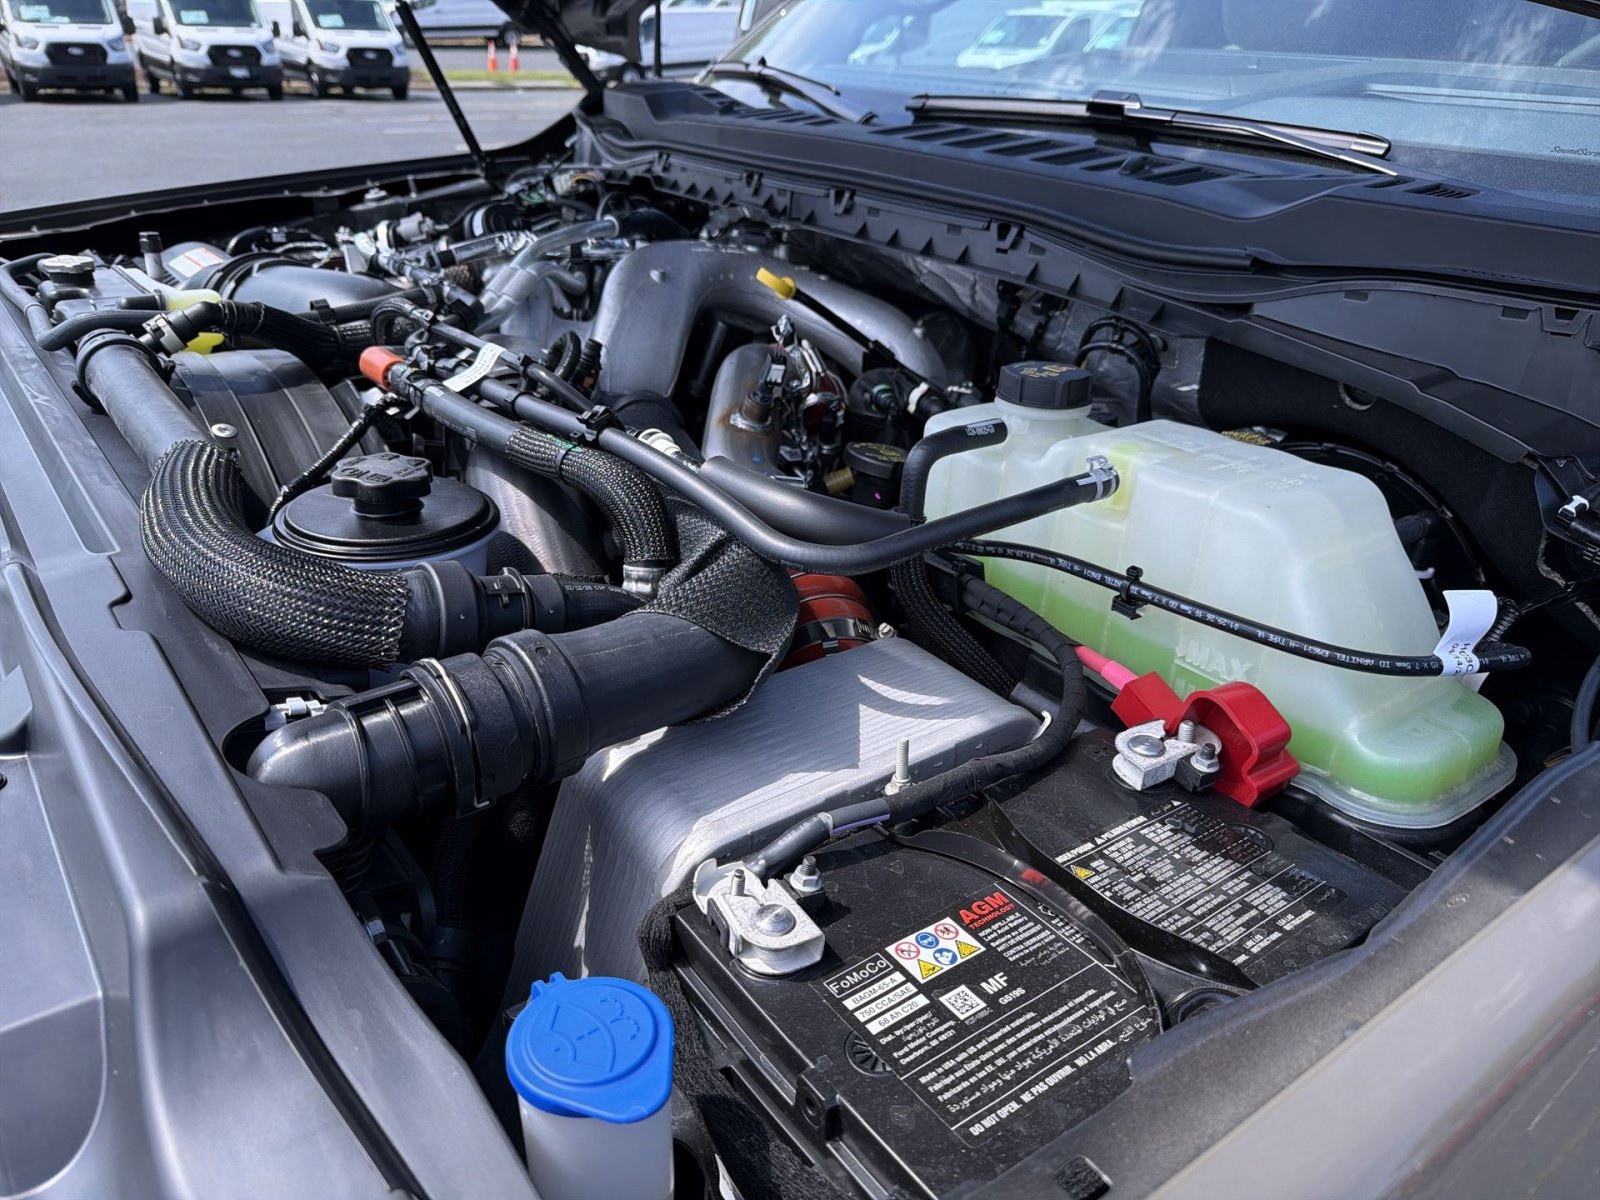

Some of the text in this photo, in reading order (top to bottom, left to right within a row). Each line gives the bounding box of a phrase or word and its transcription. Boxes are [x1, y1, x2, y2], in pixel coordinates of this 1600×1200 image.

[1254, 629, 1265, 638] UL
[1267, 632, 1286, 645] TYPE
[1185, 640, 1253, 681] MAX
[1333, 651, 1375, 666] ARNITEL
[960, 892, 1010, 924] AGM
[969, 904, 1014, 930] TECHNOLOGY
[1008, 916, 1028, 927] Battery
[830, 960, 888, 993] FoMoCo
[980, 972, 1007, 994] MF
[852, 978, 897, 1004] BAGM-65-A
[859, 986, 913, 1018] 750 CCA/SAE
[878, 1001, 918, 1026] 68 Ah C20
[879, 1034, 895, 1044] Dist.
[893, 1046, 910, 1058] Ford
[908, 1036, 926, 1048] Motor
[919, 1072, 937, 1083] Made
[942, 1060, 956, 1069] USA
[955, 1052, 969, 1062] with
[976, 1039, 988, 1049] and
[986, 1025, 1011, 1042] imported
[1010, 1012, 1037, 1028] materials.
[993, 1043, 1007, 1053] avec
[1006, 1036, 1017, 1044] des
[984, 1064, 996, 1072] EE.
[994, 1057, 1007, 1066] UU.
[969, 1040, 1117, 1135] DO NOT OPEN. NE PAS OUVRIR. NO LA ABRA.
